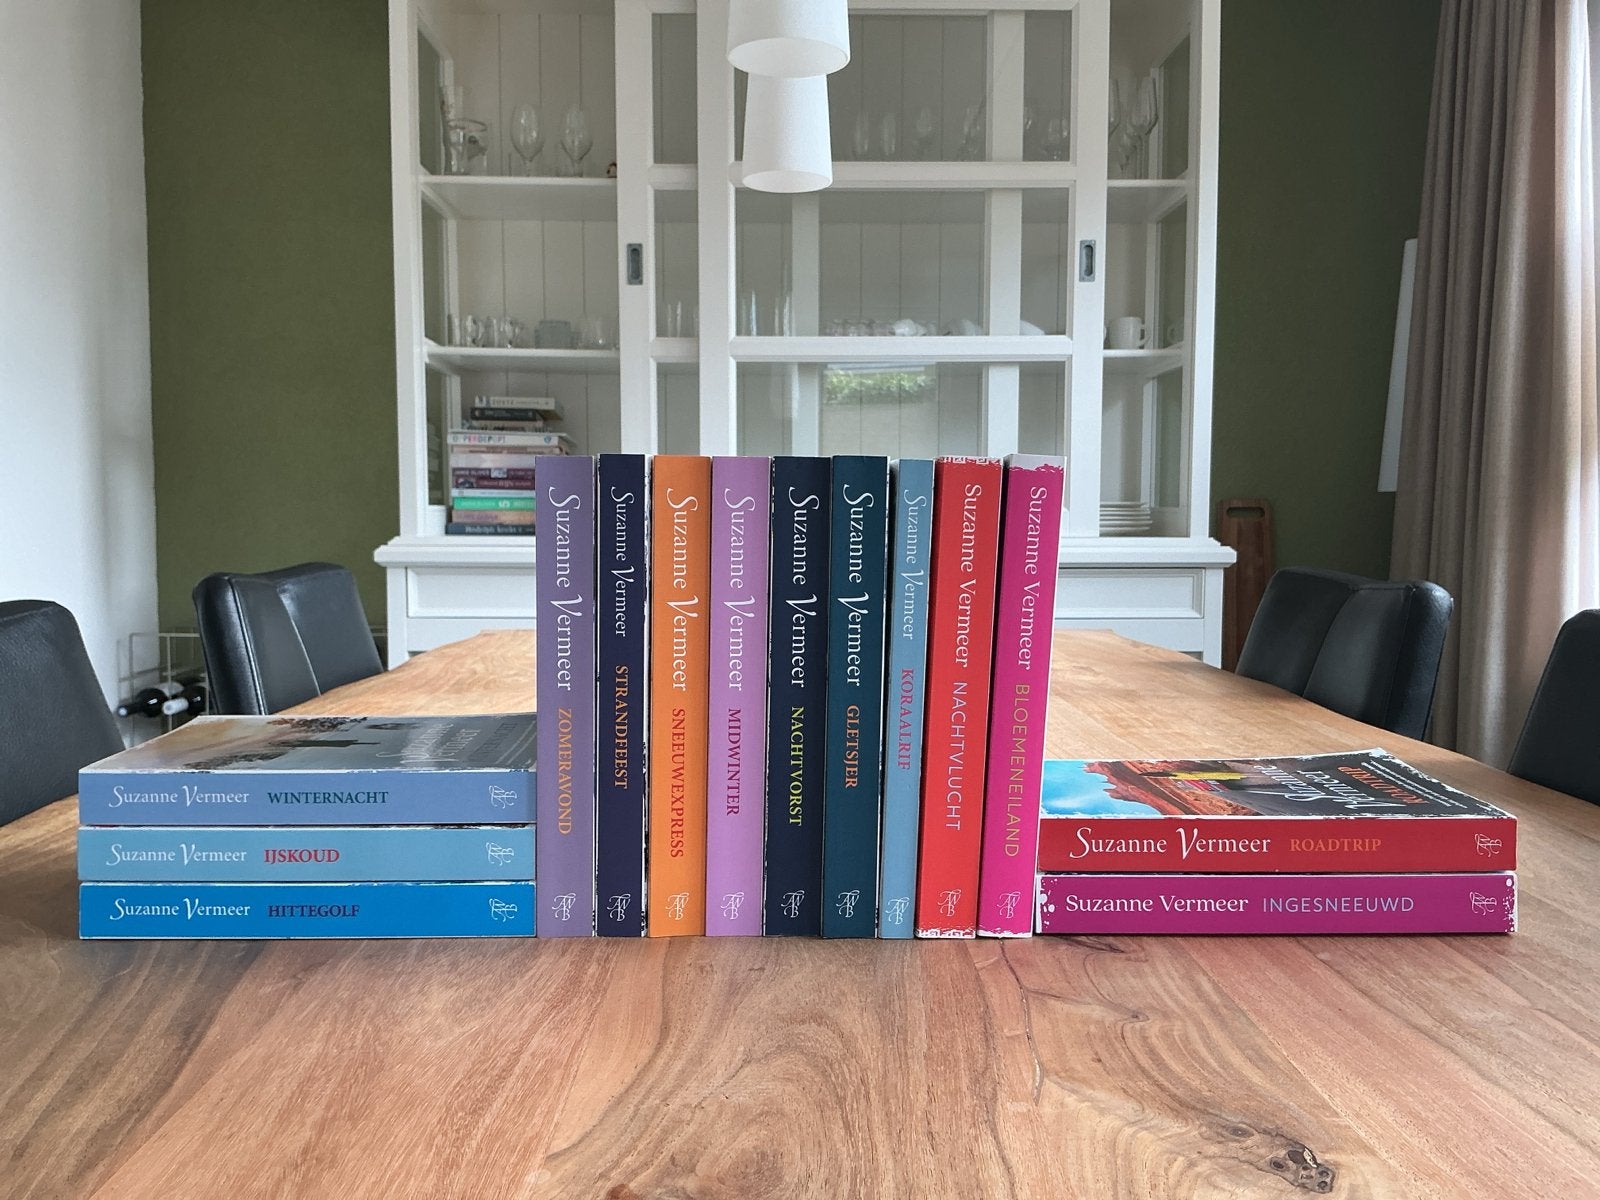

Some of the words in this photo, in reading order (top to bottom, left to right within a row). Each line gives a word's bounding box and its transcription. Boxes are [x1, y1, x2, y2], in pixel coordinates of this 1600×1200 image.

[548, 486, 581, 588] Suzanne
[610, 486, 635, 561] Suzanne
[666, 487, 699, 589] Suzanne
[724, 487, 756, 589] Suzanne
[788, 486, 820, 585] Suzanne
[842, 483, 875, 584] Suzanne
[903, 489, 927, 564] Suzanne
[960, 483, 982, 573] Suzanne
[1024, 486, 1048, 575] Suzanne
[550, 594, 583, 691] Vermeer
[610, 565, 635, 637] Vermeer
[666, 595, 699, 692] Vermeer
[723, 595, 757, 692] Vermeer
[785, 593, 818, 688] Vermeer
[837, 591, 870, 687] Vermeer
[900, 569, 925, 640] Vermeer
[955, 578, 977, 668] Vermeer
[1018, 581, 1041, 671] Vermeer
[614, 665, 629, 790] STRANDFEEST
[726, 708, 742, 816] MIDWINTER
[789, 706, 805, 827] NACHTVORST
[843, 705, 860, 789] GLETSJER
[896, 668, 915, 771] KORAALRIF
[945, 681, 968, 831] NACHTVLUCHT
[108, 785, 179, 808] Suzanne
[181, 785, 250, 808] Vermeer
[266, 791, 389, 804] WINTERNACHT
[558, 706, 574, 835] ZOMERAVOND
[670, 708, 686, 858] SNEEUWEXPRESS
[1003, 683, 1030, 857] BLOEMENEILAND
[105, 843, 176, 866] Suzanne
[179, 843, 247, 866] Vermeer
[263, 848, 341, 865] IJSKOUD
[1069, 826, 1167, 859] Suzanne
[1175, 827, 1271, 860] Vermeer
[1290, 838, 1382, 852] ROADTRIP
[109, 898, 180, 921] Suzanne
[182, 897, 251, 920] Vermeer
[267, 904, 361, 919] HITTEGOLF
[1066, 894, 1154, 912] Suzanne
[1158, 895, 1249, 912] Vermeer
[1263, 896, 1414, 913] INGESNEEUWD
